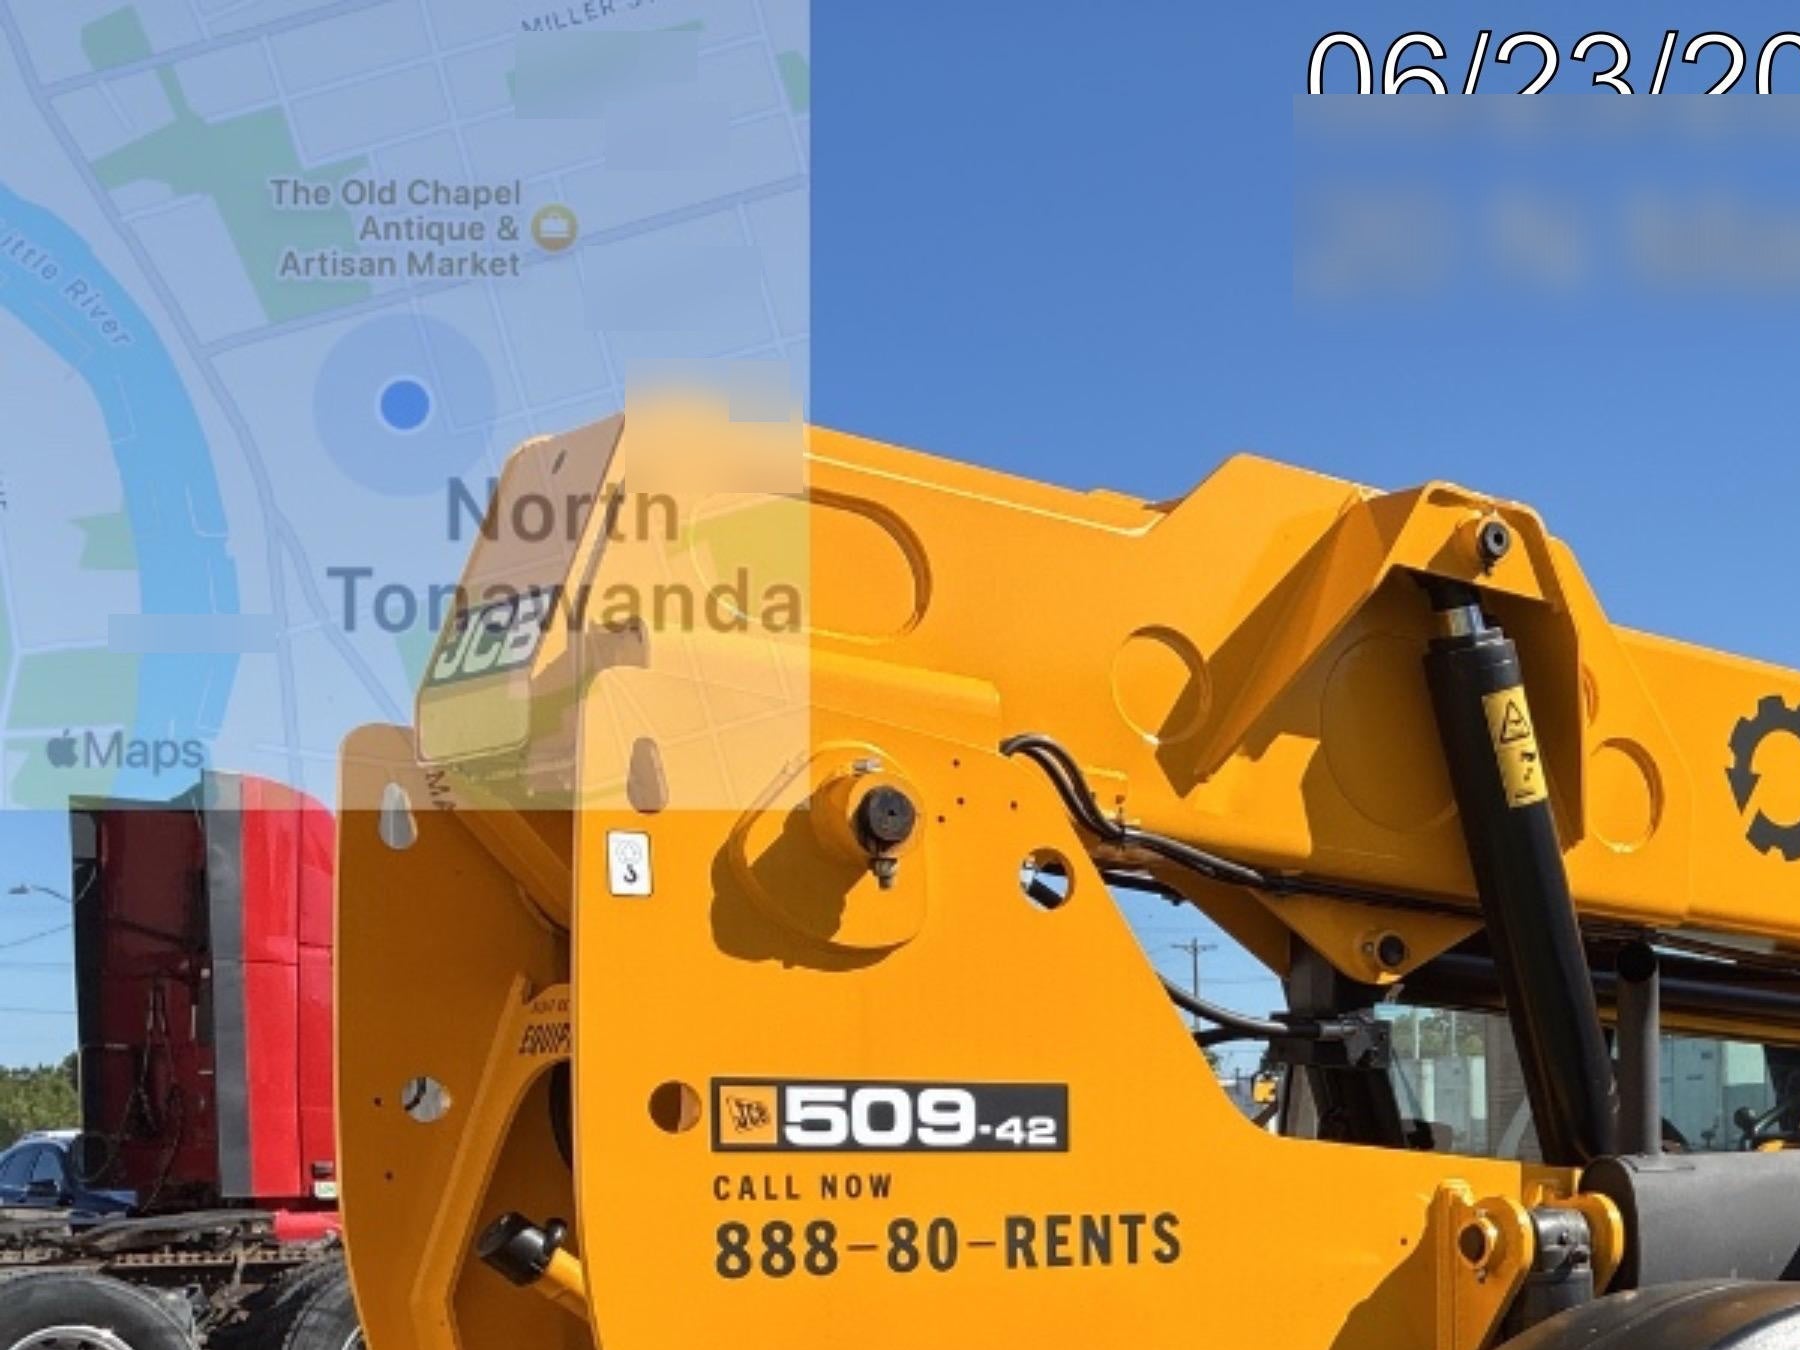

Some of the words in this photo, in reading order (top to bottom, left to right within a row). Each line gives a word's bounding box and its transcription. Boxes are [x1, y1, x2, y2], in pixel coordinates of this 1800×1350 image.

[433, 591, 551, 680] JCB
[713, 1175, 801, 1201] CALL
[821, 1173, 893, 1199] NOW
[715, 1211, 1181, 1280] 888-80-RENTS
